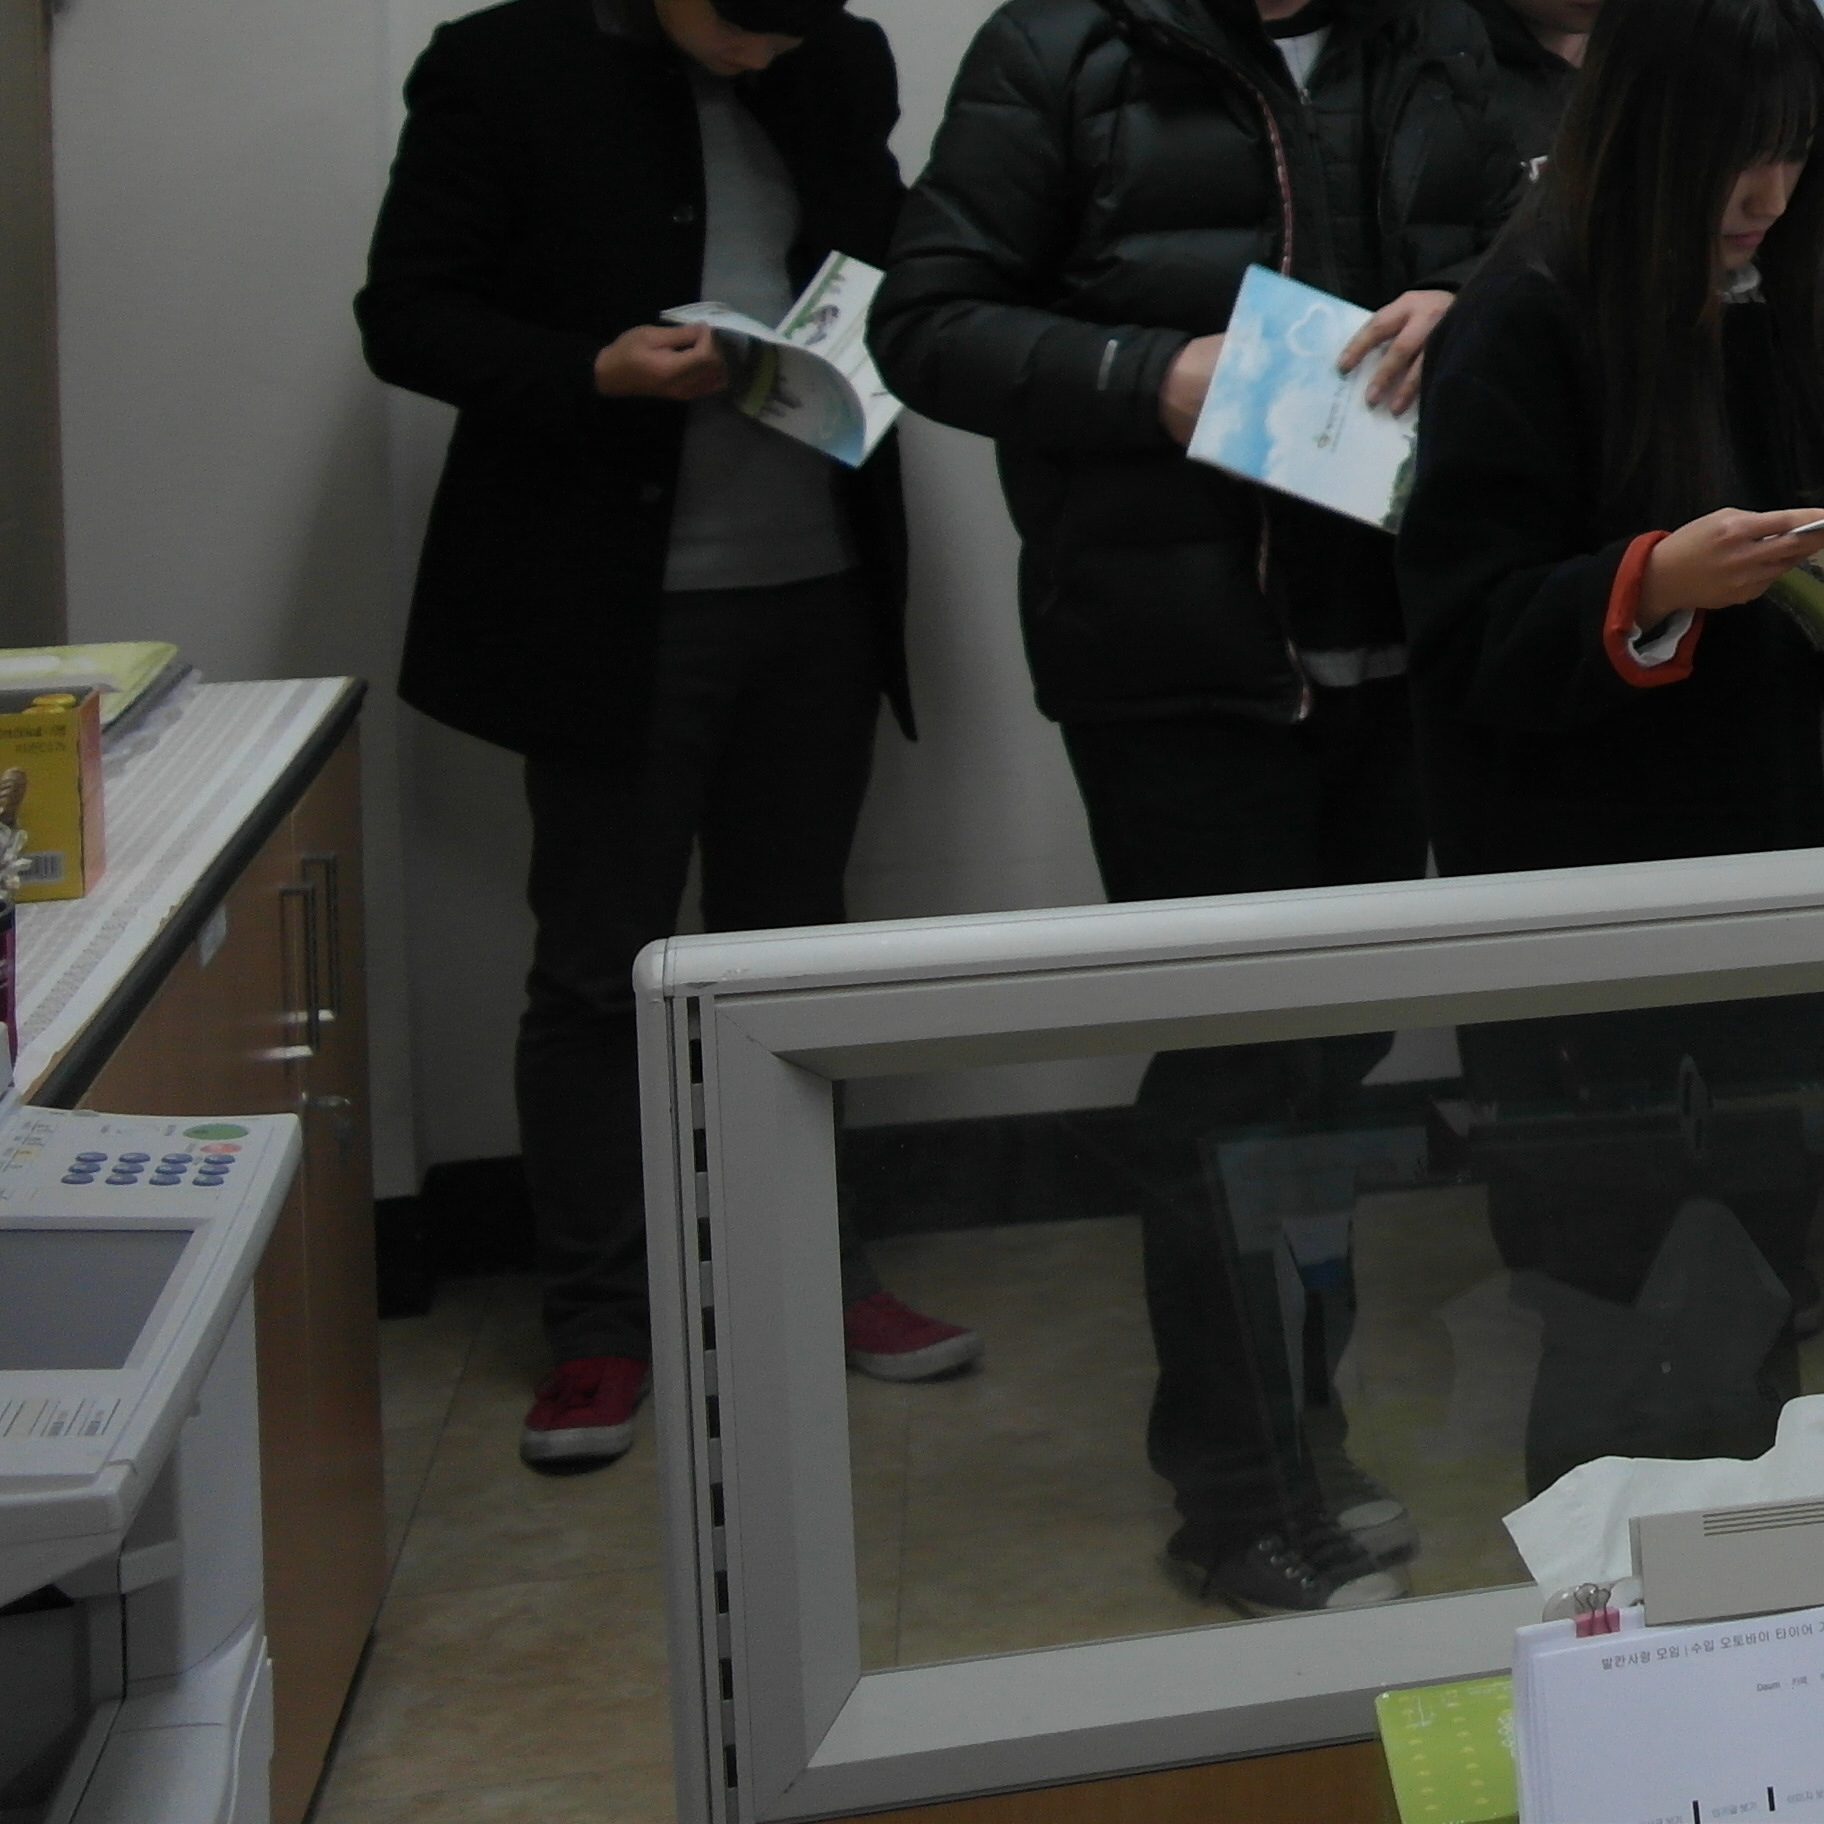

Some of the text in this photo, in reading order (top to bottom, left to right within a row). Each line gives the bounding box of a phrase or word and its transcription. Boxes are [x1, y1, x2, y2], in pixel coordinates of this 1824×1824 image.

[1691, 1638, 1715, 1655] 수입
[1720, 1630, 1770, 1651] 오토바이
[1775, 1622, 1813, 1642] 타이어
